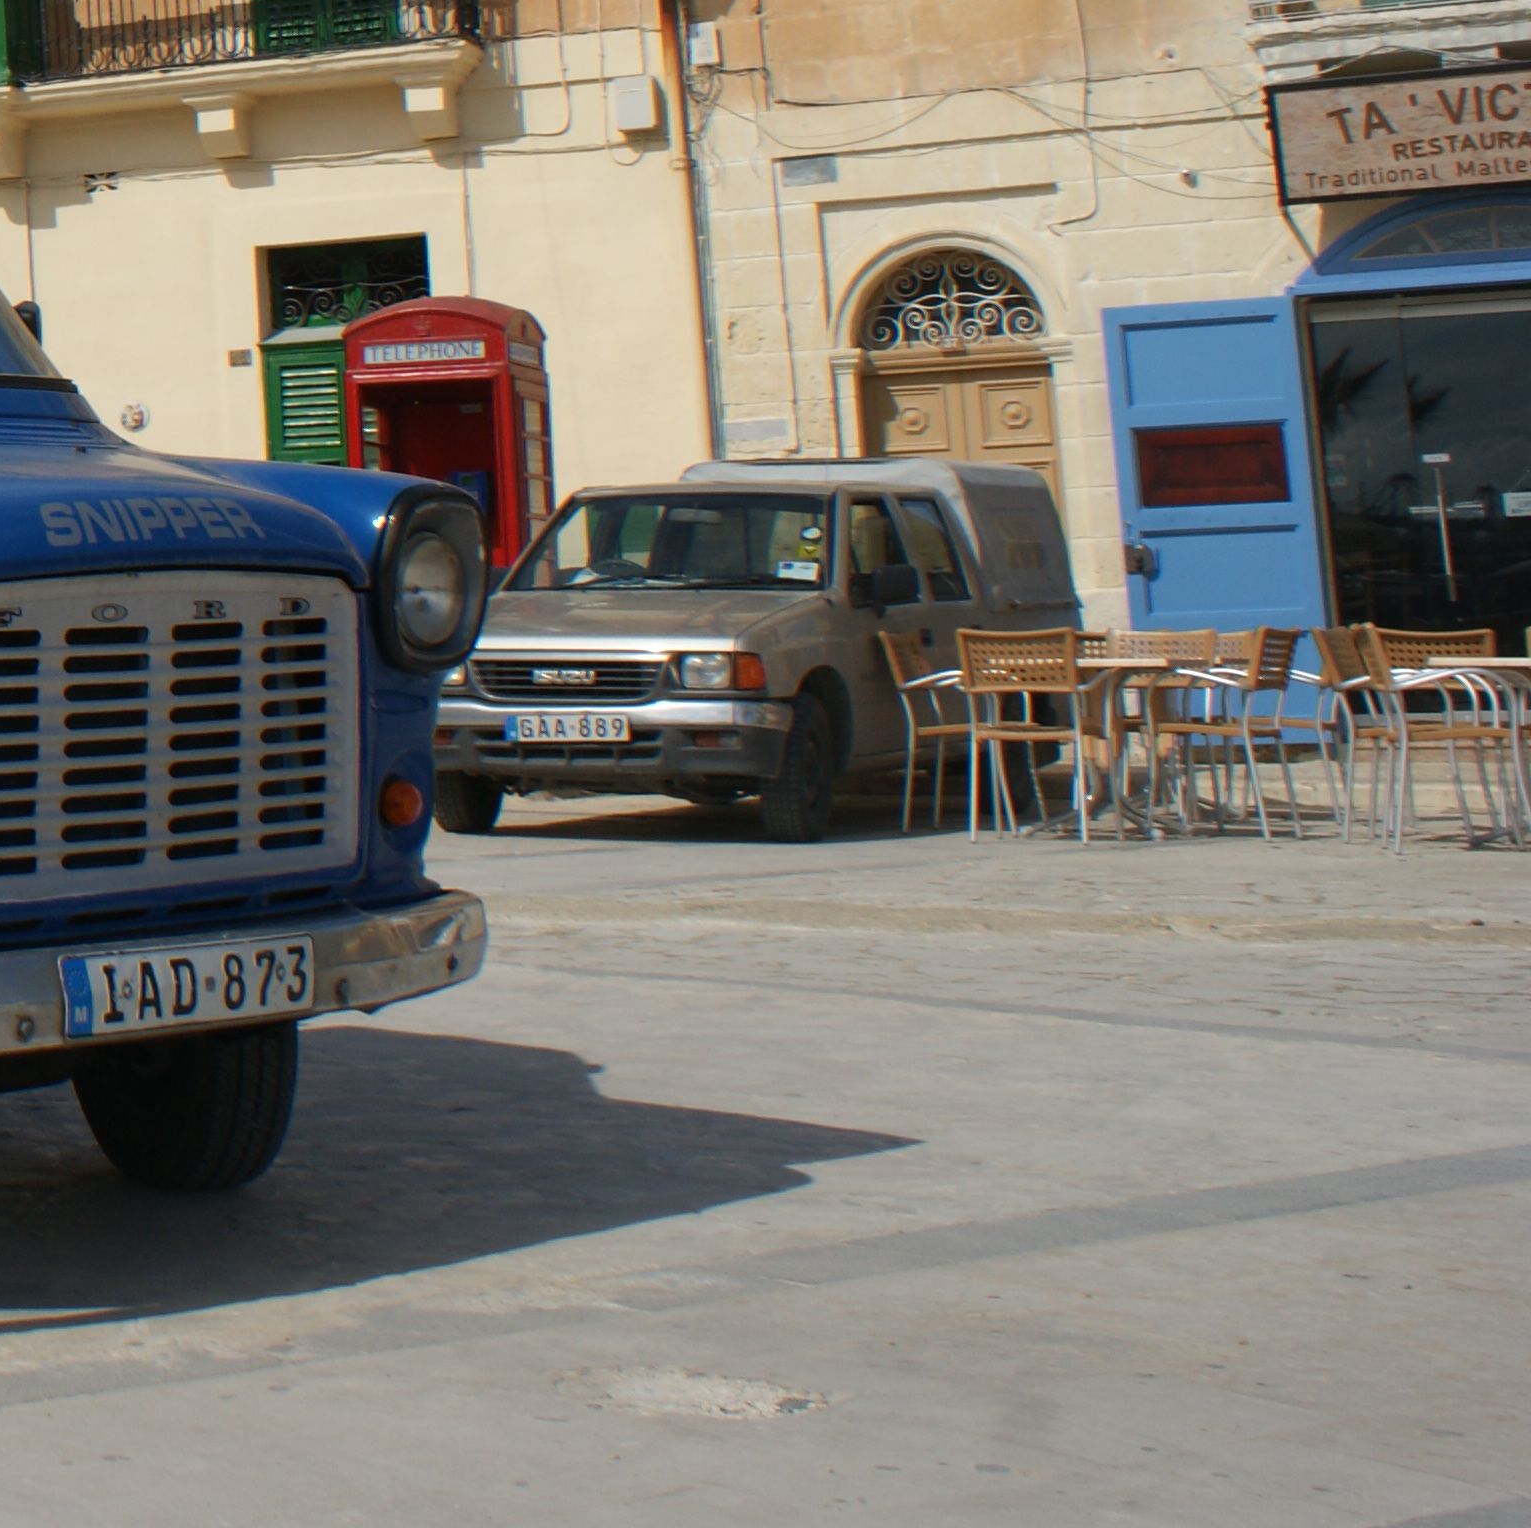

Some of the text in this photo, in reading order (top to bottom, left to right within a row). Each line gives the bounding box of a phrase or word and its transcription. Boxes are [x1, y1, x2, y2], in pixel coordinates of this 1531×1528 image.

[1306, 157, 1531, 189] Traditional Malte
[372, 341, 480, 362] TELEPHONE
[40, 496, 266, 547] SNIPPER
[532, 669, 595, 685] ISUZU
